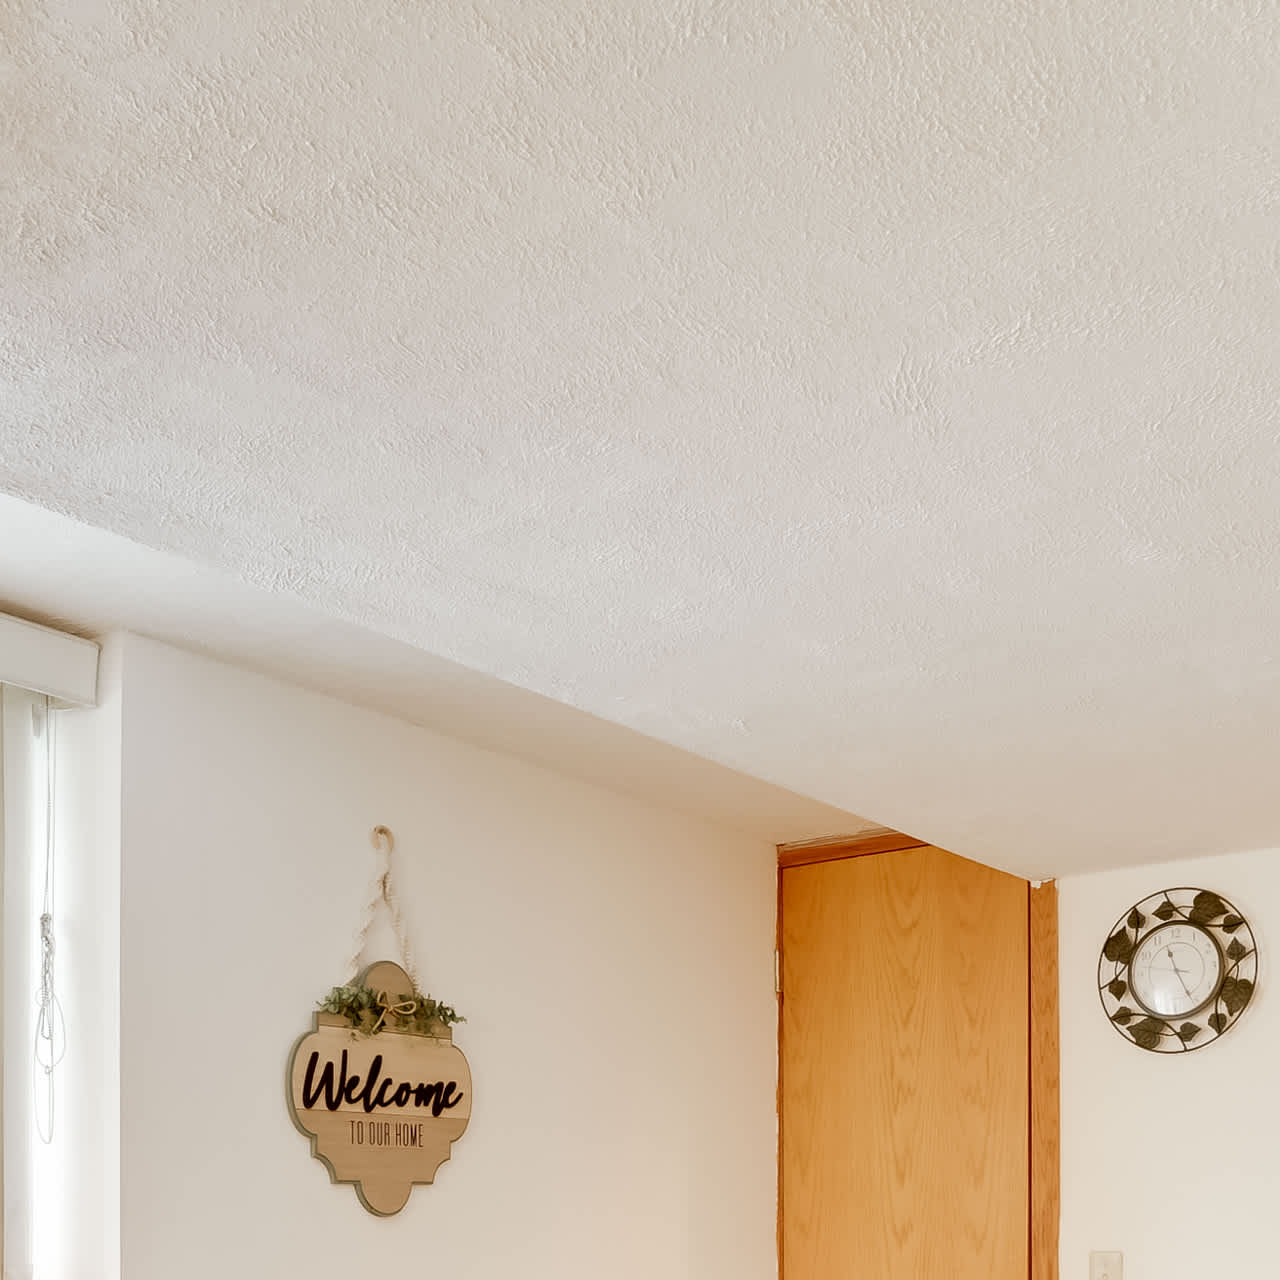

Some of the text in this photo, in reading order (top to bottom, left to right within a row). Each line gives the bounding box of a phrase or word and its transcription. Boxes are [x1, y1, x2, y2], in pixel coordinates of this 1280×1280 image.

[1171, 928, 1181, 938] 12
[302, 1049, 464, 1117] Welcome
[350, 1120, 424, 1147] TO OUR HOME
